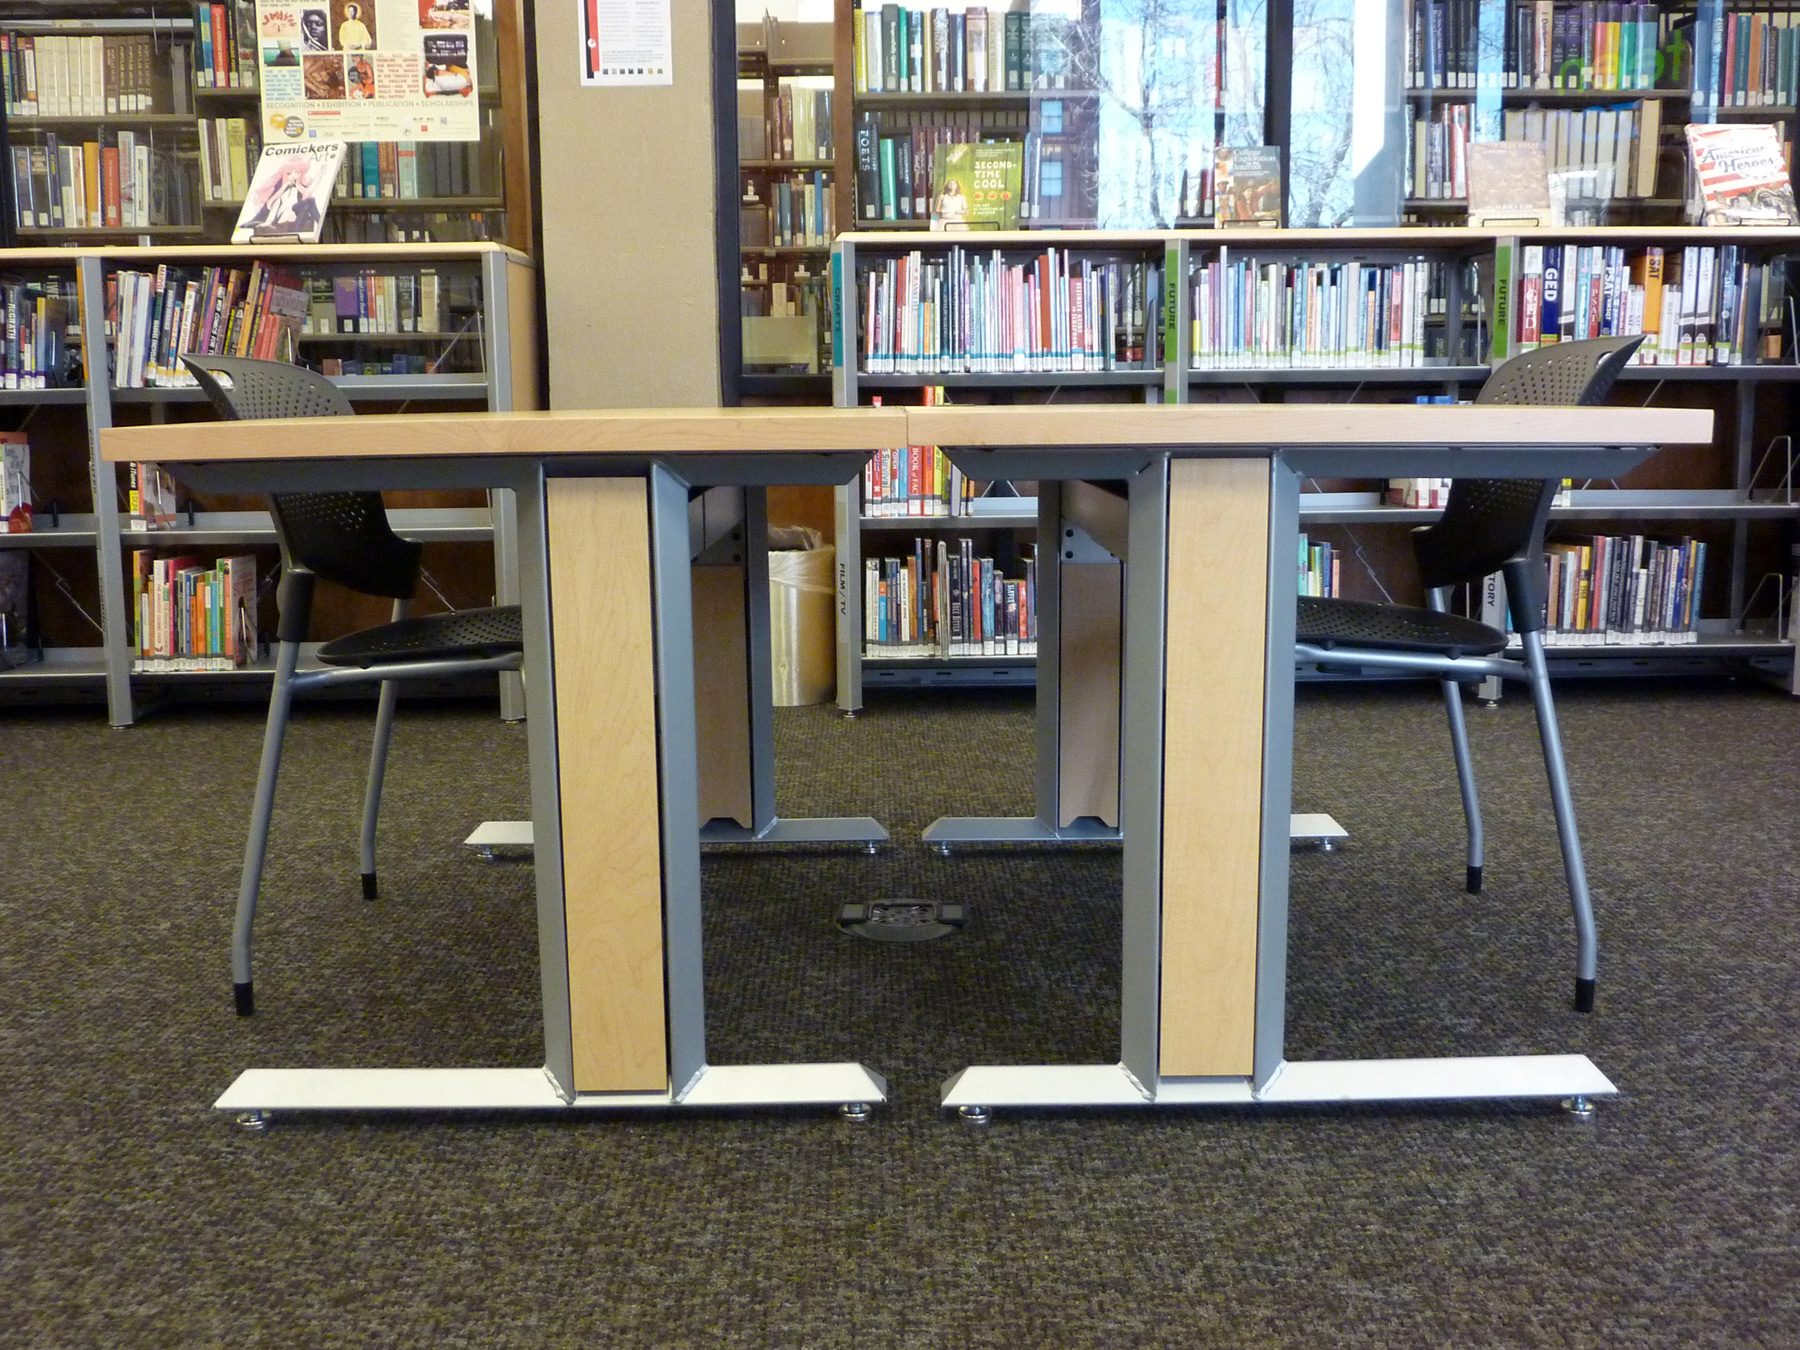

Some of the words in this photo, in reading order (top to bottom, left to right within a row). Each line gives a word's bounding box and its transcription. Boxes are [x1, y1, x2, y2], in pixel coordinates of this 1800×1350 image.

[265, 143, 339, 157] Comickers
[860, 130, 871, 171] POETS
[974, 161, 1017, 169] SECOND-
[974, 170, 1001, 178] TIME
[1718, 157, 1774, 173] Heroes
[973, 180, 1005, 189] COOL
[1649, 259, 1660, 280] SAT
[1544, 268, 1558, 301] GED
[1075, 282, 1083, 312] ULTIMATE
[1168, 283, 1177, 330] FUTURE
[1498, 279, 1508, 325] FUTURE
[1591, 288, 1599, 322] PSAT
[7, 303, 17, 339] McGRATH
[834, 287, 842, 333] CRAFTS
[212, 312, 220, 334] COMICS
[209, 335, 217, 347] FOR
[882, 454, 891, 488] Survival
[911, 447, 919, 471] BOOK
[911, 478, 919, 495] FAC
[1487, 574, 1497, 607] TORY
[840, 600, 846, 616] TV
